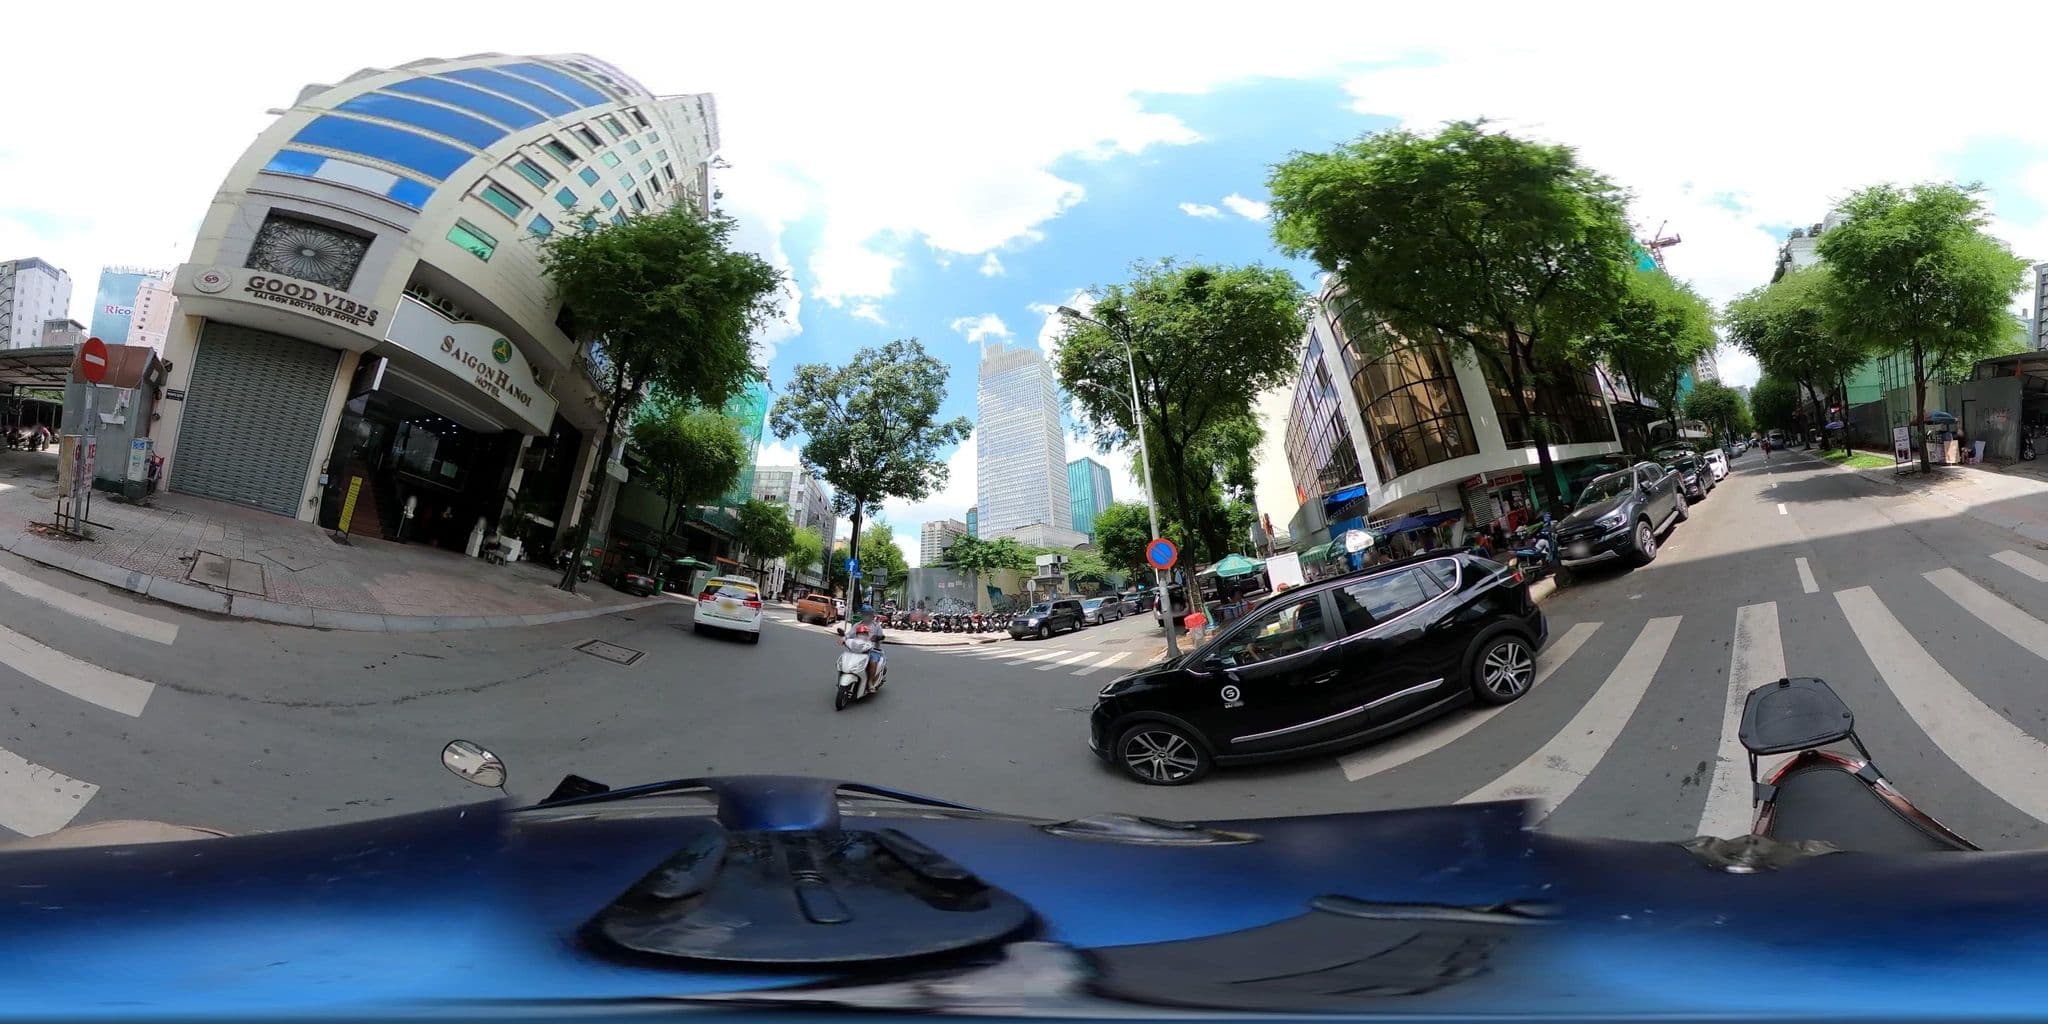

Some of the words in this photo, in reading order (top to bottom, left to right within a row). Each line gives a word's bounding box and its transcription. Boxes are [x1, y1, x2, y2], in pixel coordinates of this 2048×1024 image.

[106, 305, 131, 315] Rico
[249, 276, 317, 300] GOOD
[323, 292, 379, 322] VIBES
[253, 291, 288, 305] SAIGON
[289, 299, 332, 317] BOUTIQUE
[333, 312, 360, 326] HOTEL
[475, 375, 500, 397] HOTEL
